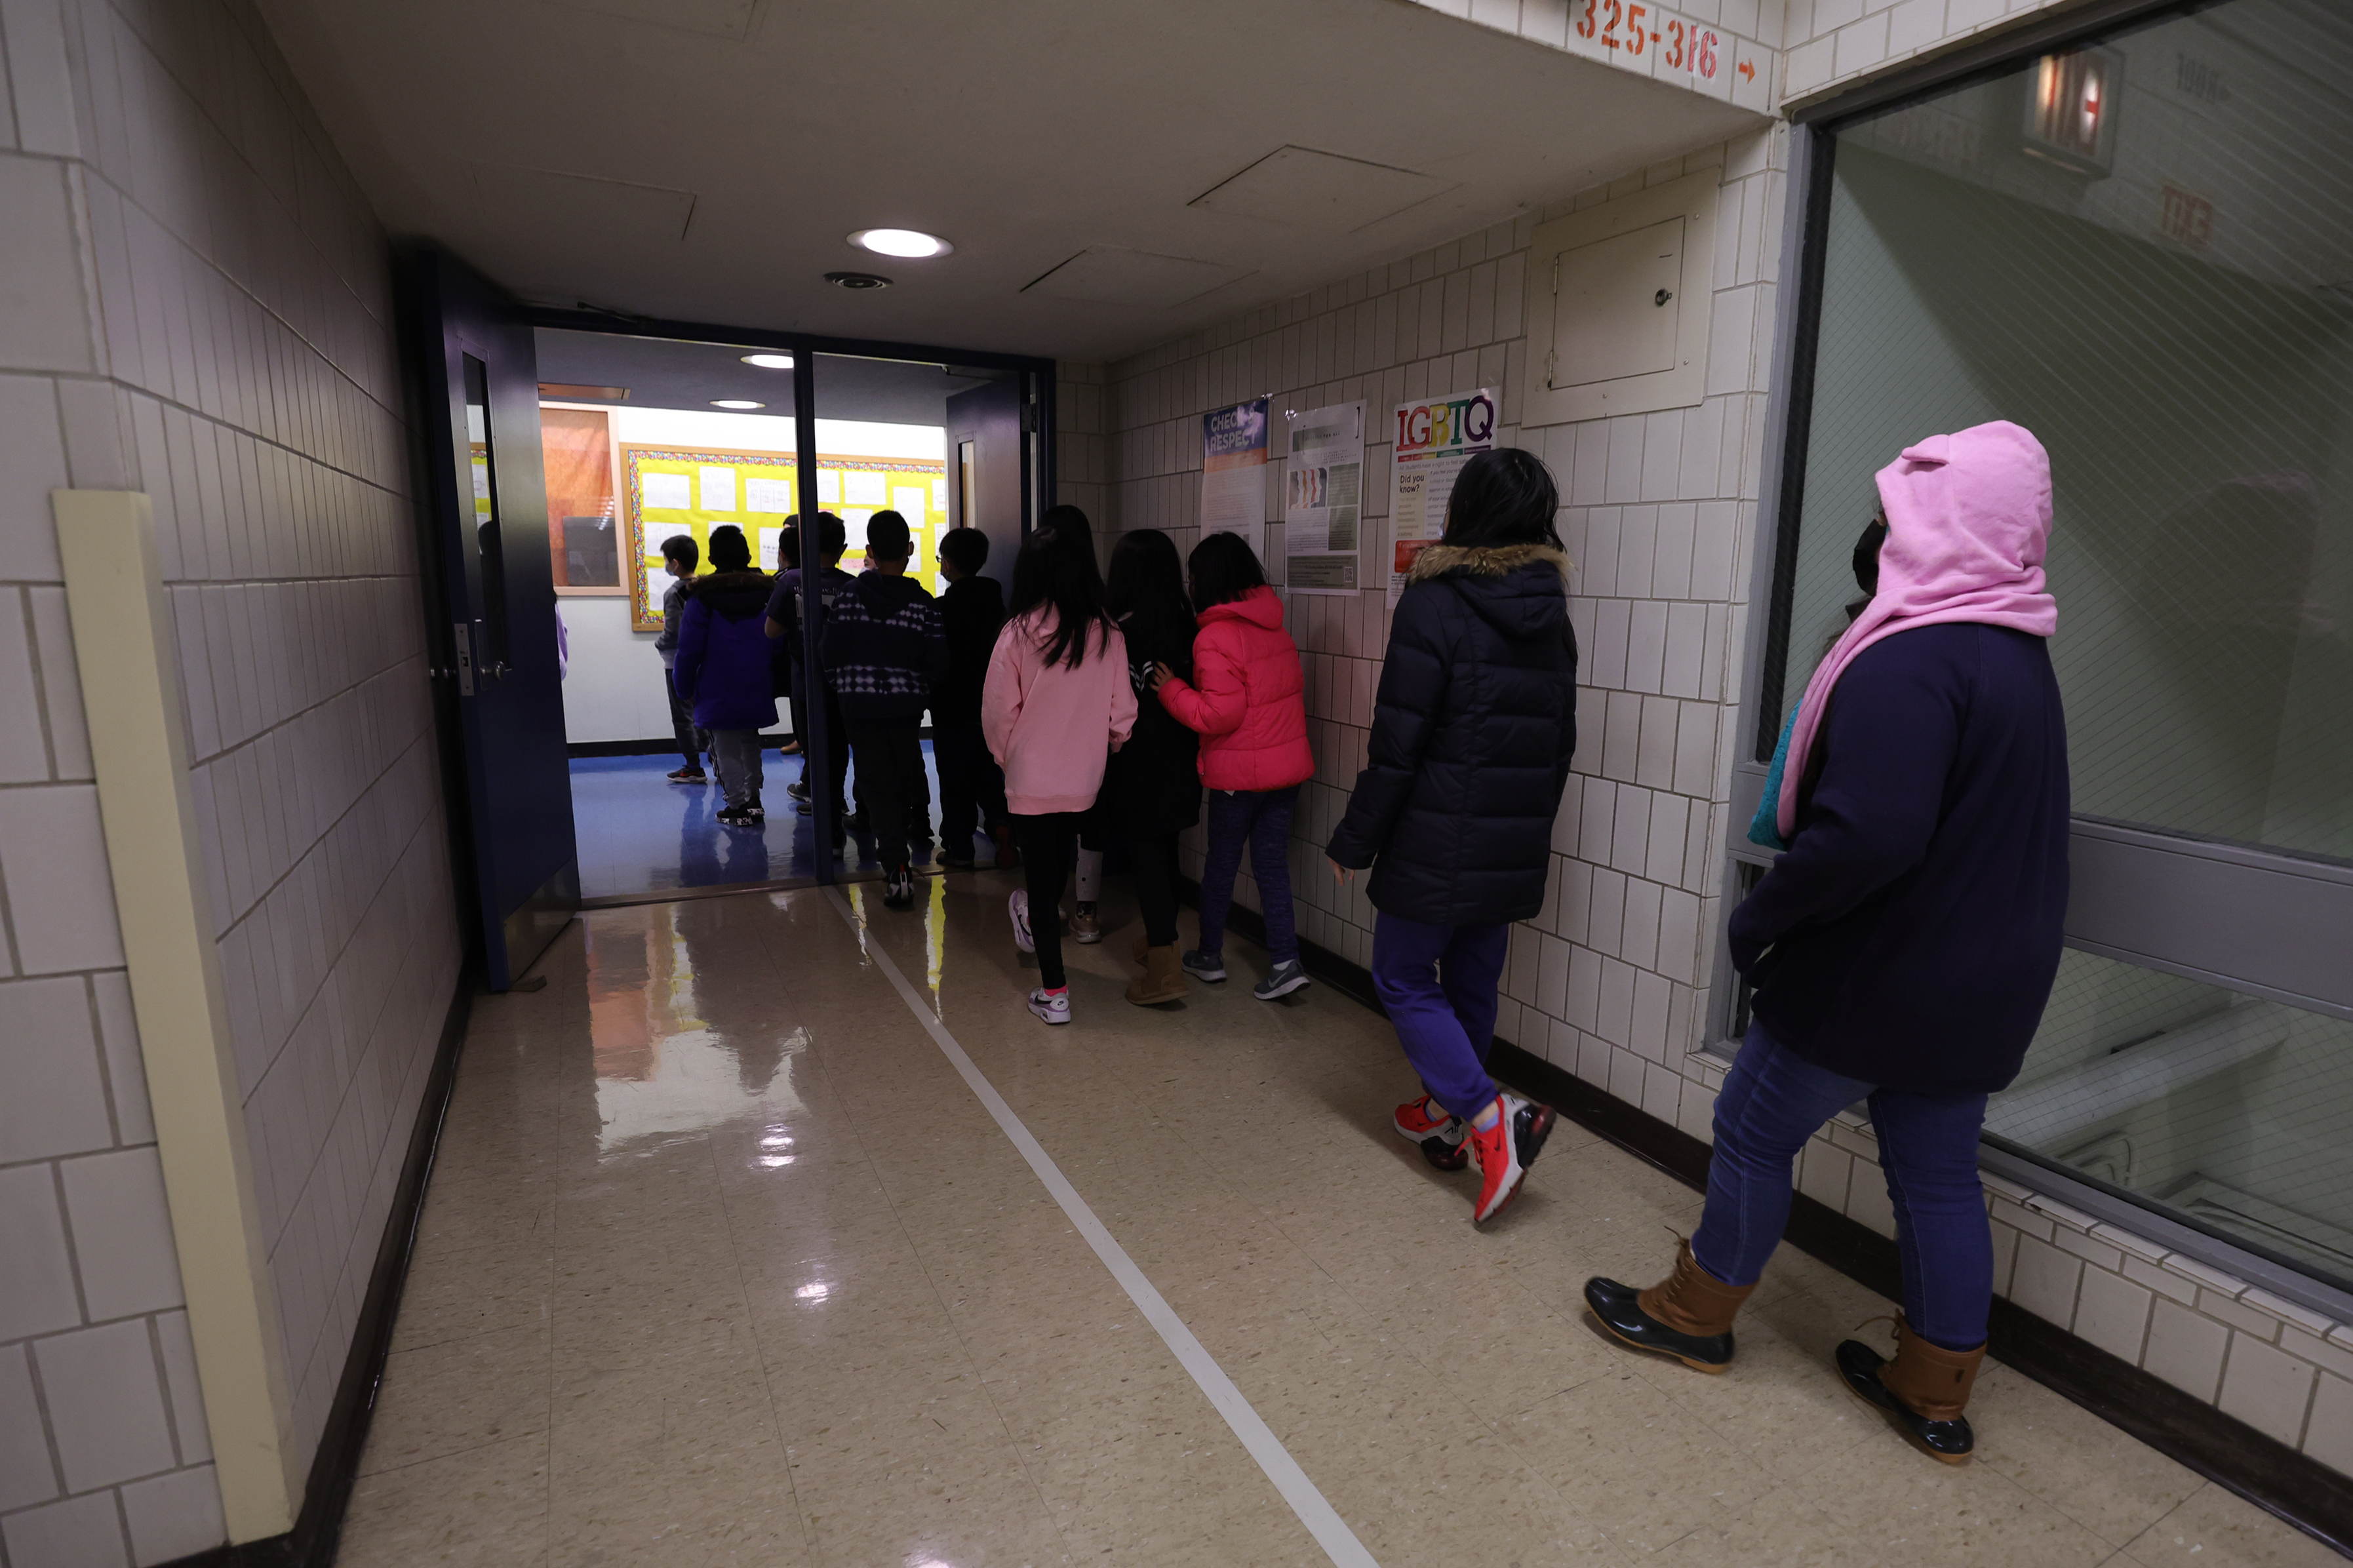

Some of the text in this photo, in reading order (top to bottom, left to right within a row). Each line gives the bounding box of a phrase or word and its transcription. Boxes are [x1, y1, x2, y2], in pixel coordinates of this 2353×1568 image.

[1576, 0, 1718, 79] 325-316
[1396, 395, 1494, 452] LGBTQ
[1210, 427, 1256, 452] RESPECT
[1399, 484, 1420, 494] know?
[1400, 474, 1425, 484] Did you
